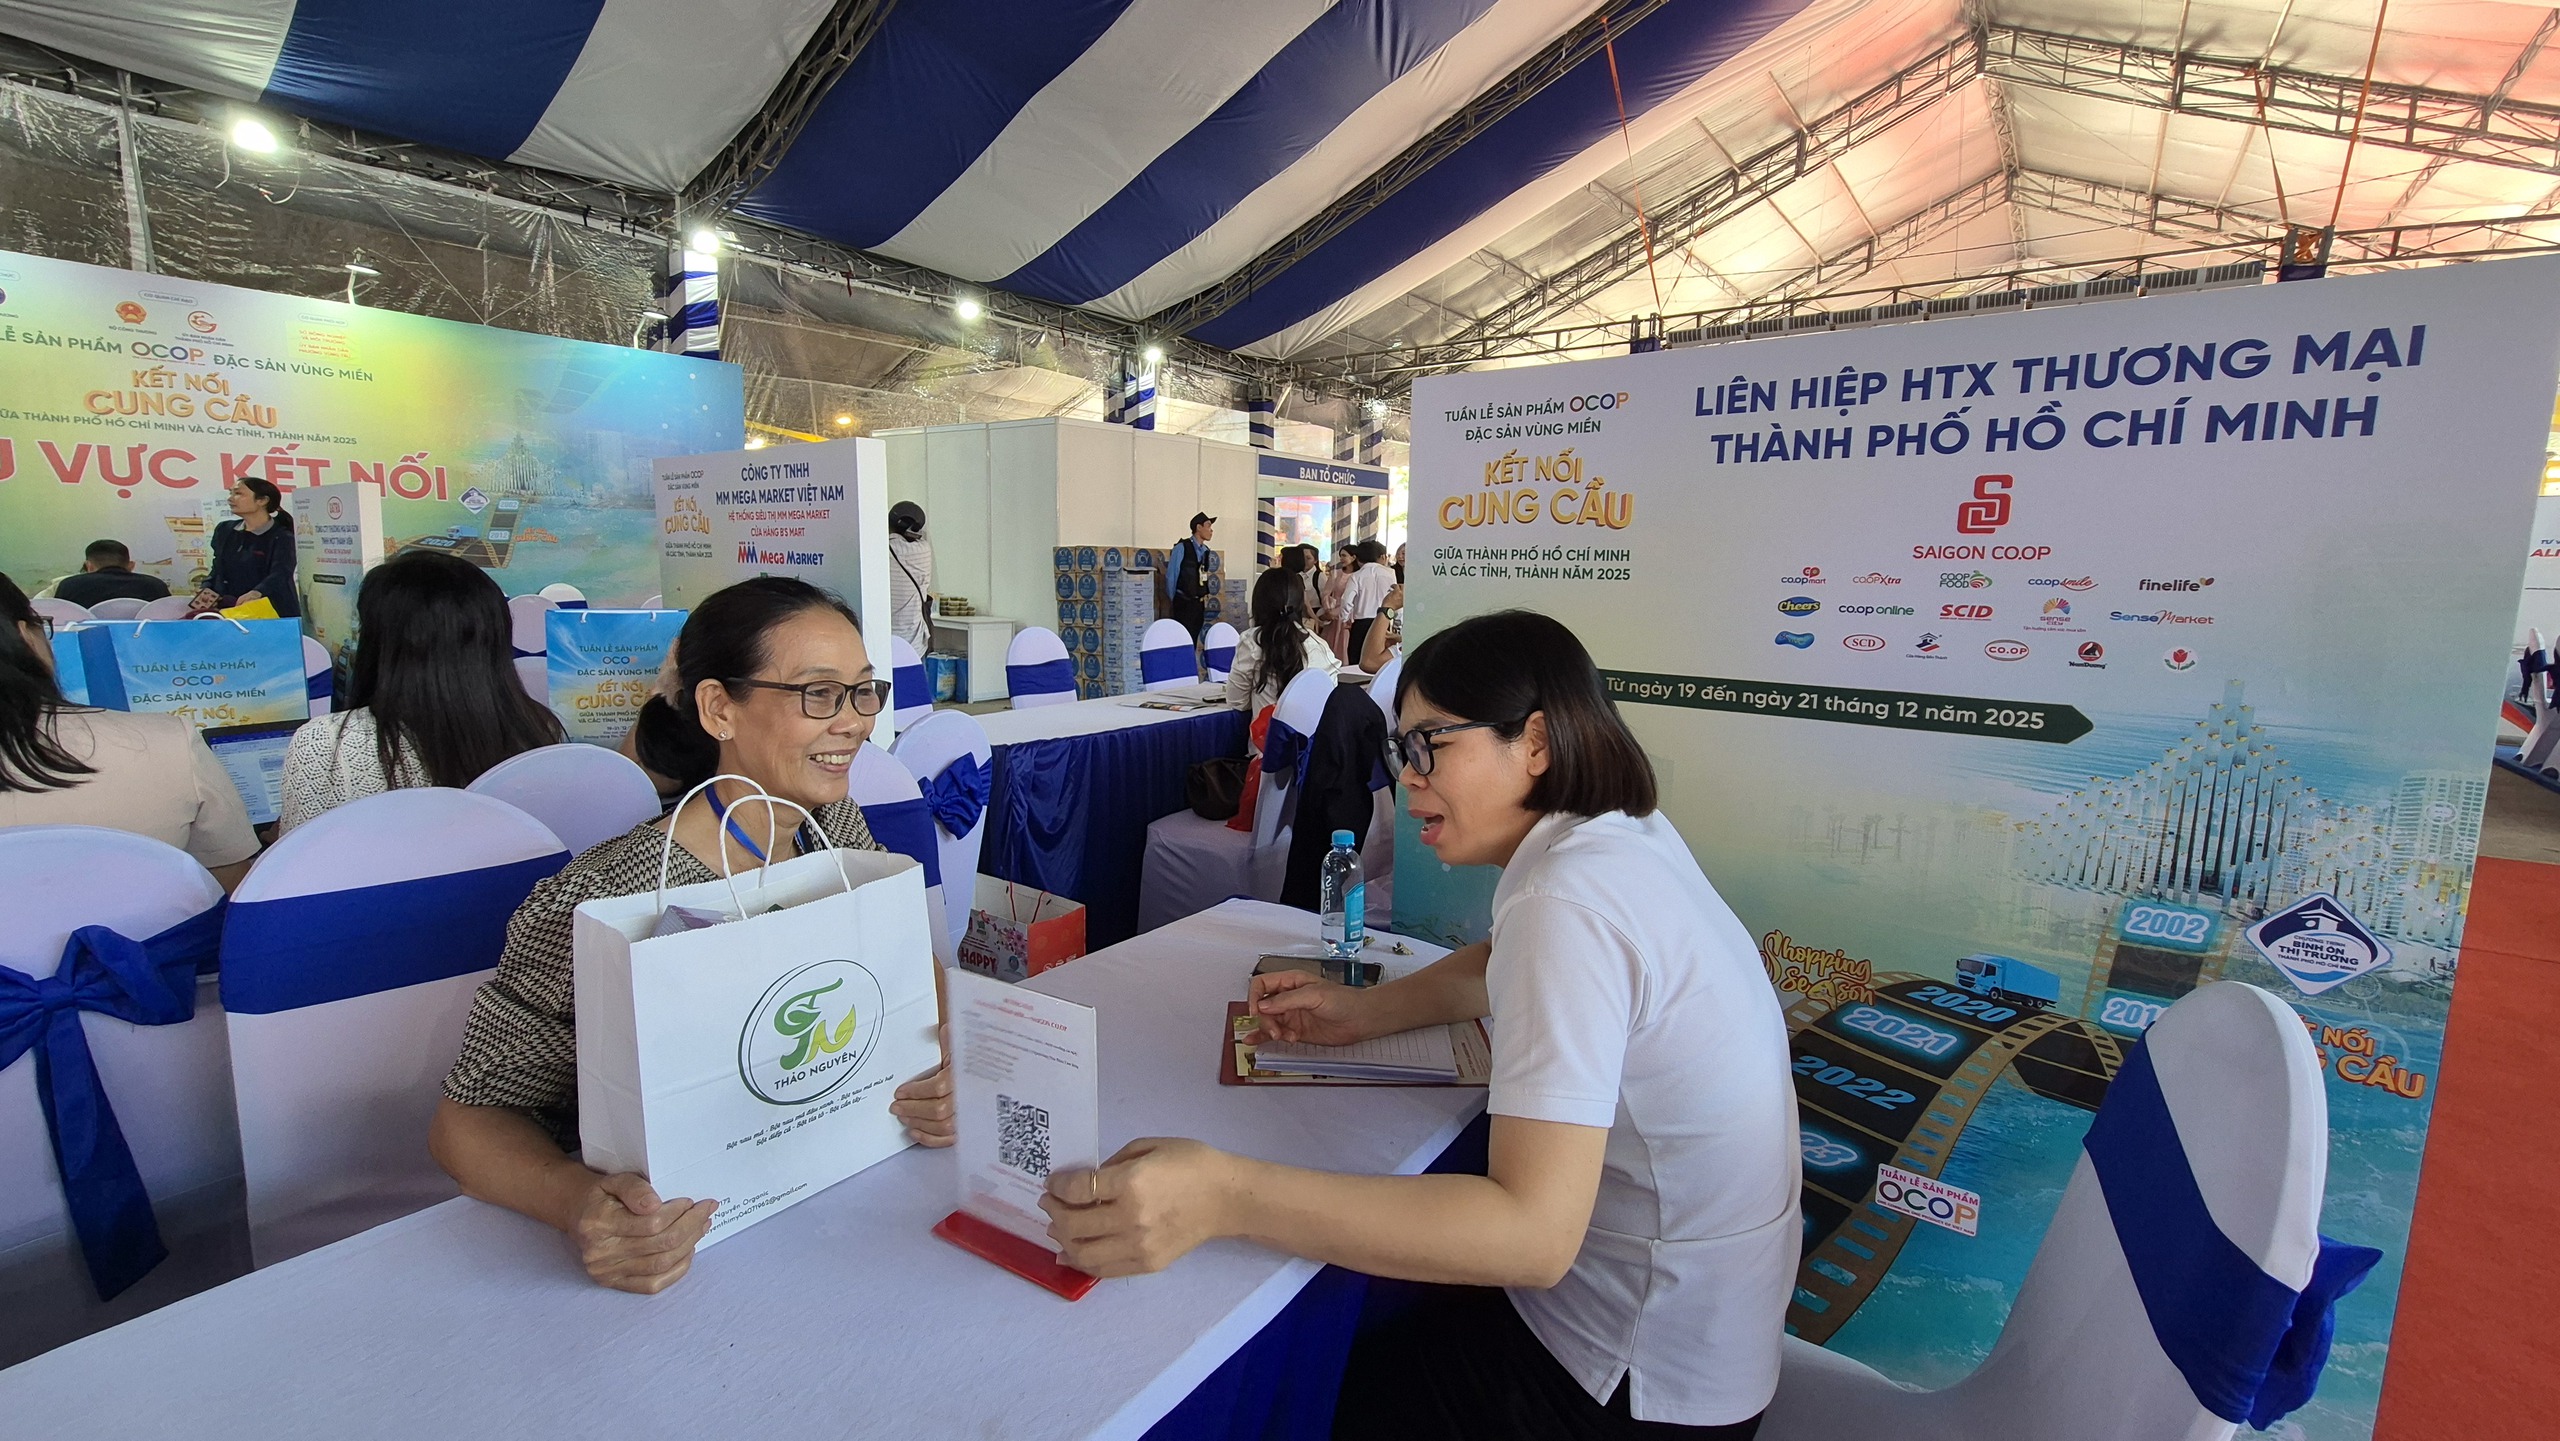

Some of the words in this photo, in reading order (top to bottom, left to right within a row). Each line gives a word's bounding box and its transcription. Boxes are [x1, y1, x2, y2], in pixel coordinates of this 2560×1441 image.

[22, 330, 62, 348] SẢN
[68, 336, 122, 354] PHẨM
[131, 341, 204, 362] OCOP
[213, 353, 250, 369] ĐẶC
[255, 357, 286, 372] SẢN
[290, 362, 334, 377] VÙNG
[339, 368, 373, 381] MIỀN
[133, 365, 177, 389] KẾT
[184, 372, 230, 396] NỐI
[1695, 375, 1777, 416] LIÊN
[1790, 366, 1888, 416] HIỆP
[1901, 361, 1998, 402] HTX
[2012, 338, 2271, 394] THƯƠNG
[2292, 324, 2427, 382] MẠI
[83, 390, 195, 417] CUNG
[204, 394, 279, 429] CẦU
[1444, 406, 1477, 422] TUẦN
[1480, 402, 1494, 420] LỄ
[1496, 402, 1523, 418] SẢN
[1526, 397, 1565, 416] PHẨM
[1569, 392, 1630, 412] OCOP
[23, 409, 70, 423] THÀNH
[73, 413, 102, 425] PHỐ
[105, 415, 126, 428] HỒ
[128, 418, 151, 429] CHÍ
[154, 422, 185, 432] MINH
[188, 423, 203, 433] VÀ
[207, 424, 233, 436] CÁC
[268, 429, 304, 441] THÀNH
[306, 431, 331, 443] NĂM
[333, 435, 358, 445] 2025
[1465, 426, 1493, 443] ĐẶC
[1495, 423, 1522, 439] SẢN
[1525, 421, 1564, 437] VÙNG
[1567, 417, 1601, 434] MIỀN
[1710, 422, 1853, 464] THÀNH
[1866, 405, 1973, 457] PHỐ
[1985, 400, 2066, 452] HỒ
[2083, 396, 2193, 448] CHÍ
[2204, 395, 2379, 443] MINH
[37, 440, 199, 499] VỰC
[220, 443, 331, 493] KẾT
[348, 452, 448, 501] NỐI
[741, 463, 768, 481] CÔNG
[770, 465, 781, 480] TY
[783, 462, 810, 478] TNHH
[1300, 467, 1318, 480] BAN
[1319, 464, 1331, 482] TỔ
[1332, 469, 1356, 485] CHỨC
[1484, 448, 1529, 486] KẾT
[1534, 447, 1584, 483] NỐI
[715, 491, 730, 505] MM
[732, 489, 757, 504] MEGA
[758, 487, 795, 503] MARKET
[796, 483, 818, 506] VIỆT
[820, 485, 844, 501] NAM
[1438, 487, 1541, 530] CUNG
[1550, 475, 1634, 530] CẦU
[728, 510, 735, 523] HỆ
[736, 508, 754, 521] THỐNG
[755, 509, 767, 520] SIÊU
[767, 511, 776, 522] THỊ
[777, 510, 787, 520] MM
[788, 510, 805, 520] MEGA
[805, 509, 830, 519] MARKET
[750, 525, 762, 537] CỬA
[763, 526, 779, 537] HÀNG
[789, 527, 805, 536] MART
[759, 550, 785, 564] Mega
[786, 551, 824, 565] Market
[1433, 545, 1463, 560] GIỮA
[1466, 546, 1508, 560] THÀNH
[1511, 545, 1539, 561] PHỐ
[1542, 545, 1562, 561] HỒ
[1566, 546, 1590, 561] CHÍ
[1593, 549, 1630, 561] MINH
[1912, 545, 1986, 560] SAIGON
[1991, 545, 2051, 561] CO.OP
[1432, 562, 1447, 576] VÀ
[1450, 562, 1477, 577] CÁC
[1480, 563, 1511, 580] TỈNH,
[1515, 563, 1559, 579] THÀNH
[1562, 565, 1593, 580] NĂM
[1597, 568, 1631, 580] 2025
[1939, 580, 1970, 589] FOOD
[2139, 578, 2200, 592] finelife
[1779, 600, 1820, 611] Cheers
[1875, 605, 1915, 616] online
[1939, 604, 1993, 618] SCID
[1852, 638, 1876, 648] SCD
[1988, 646, 2028, 655] CO.OP
[190, 661, 218, 671] SẢN
[577, 669, 596, 677] ĐẶC
[598, 668, 616, 676] SẢN
[617, 667, 642, 676] VÙNG
[172, 675, 227, 687] OCOP
[597, 679, 618, 693] KẾT
[132, 693, 162, 705] ĐẶC
[165, 691, 192, 702] SẢN
[196, 689, 233, 700] VÙNG
[575, 693, 626, 710] CUNG
[1606, 676, 1626, 692] Từ
[1628, 681, 1673, 699] ngày
[1677, 683, 1697, 698] 19
[1700, 684, 1737, 702] đến
[1742, 690, 1793, 710] ngày
[1798, 692, 1818, 710] 21
[1824, 697, 1890, 720] tháng
[1896, 700, 1919, 719] 12
[1925, 705, 1977, 724] năm
[1983, 708, 2045, 730] 2025
[203, 703, 236, 720] NỐI
[2126, 907, 2209, 942] 2002
[1759, 929, 1872, 985] Shopping
[2293, 940, 2323, 952] BÌNH
[960, 947, 998, 975] HAPPY
[1906, 985, 2017, 1023] 2020
[2101, 997, 2160, 1028] 201
[1843, 1007, 1957, 1055] 2021
[2321, 1027, 2376, 1057] NỐI
[774, 1071, 806, 1090] THẢO
[809, 1050, 857, 1077] NGUYÊN
[2335, 1055, 2426, 1099] CẦU
[1792, 1055, 1916, 1111] 2022
[742, 1190, 769, 1206] Organic
[1880, 1168, 1907, 1183] TUẦN
[1909, 1176, 1920, 1187] LỄ
[1922, 1181, 1943, 1195] SẢN
[1946, 1191, 1978, 1206] PHẨM
[1878, 1180, 1977, 1225] OCOP
